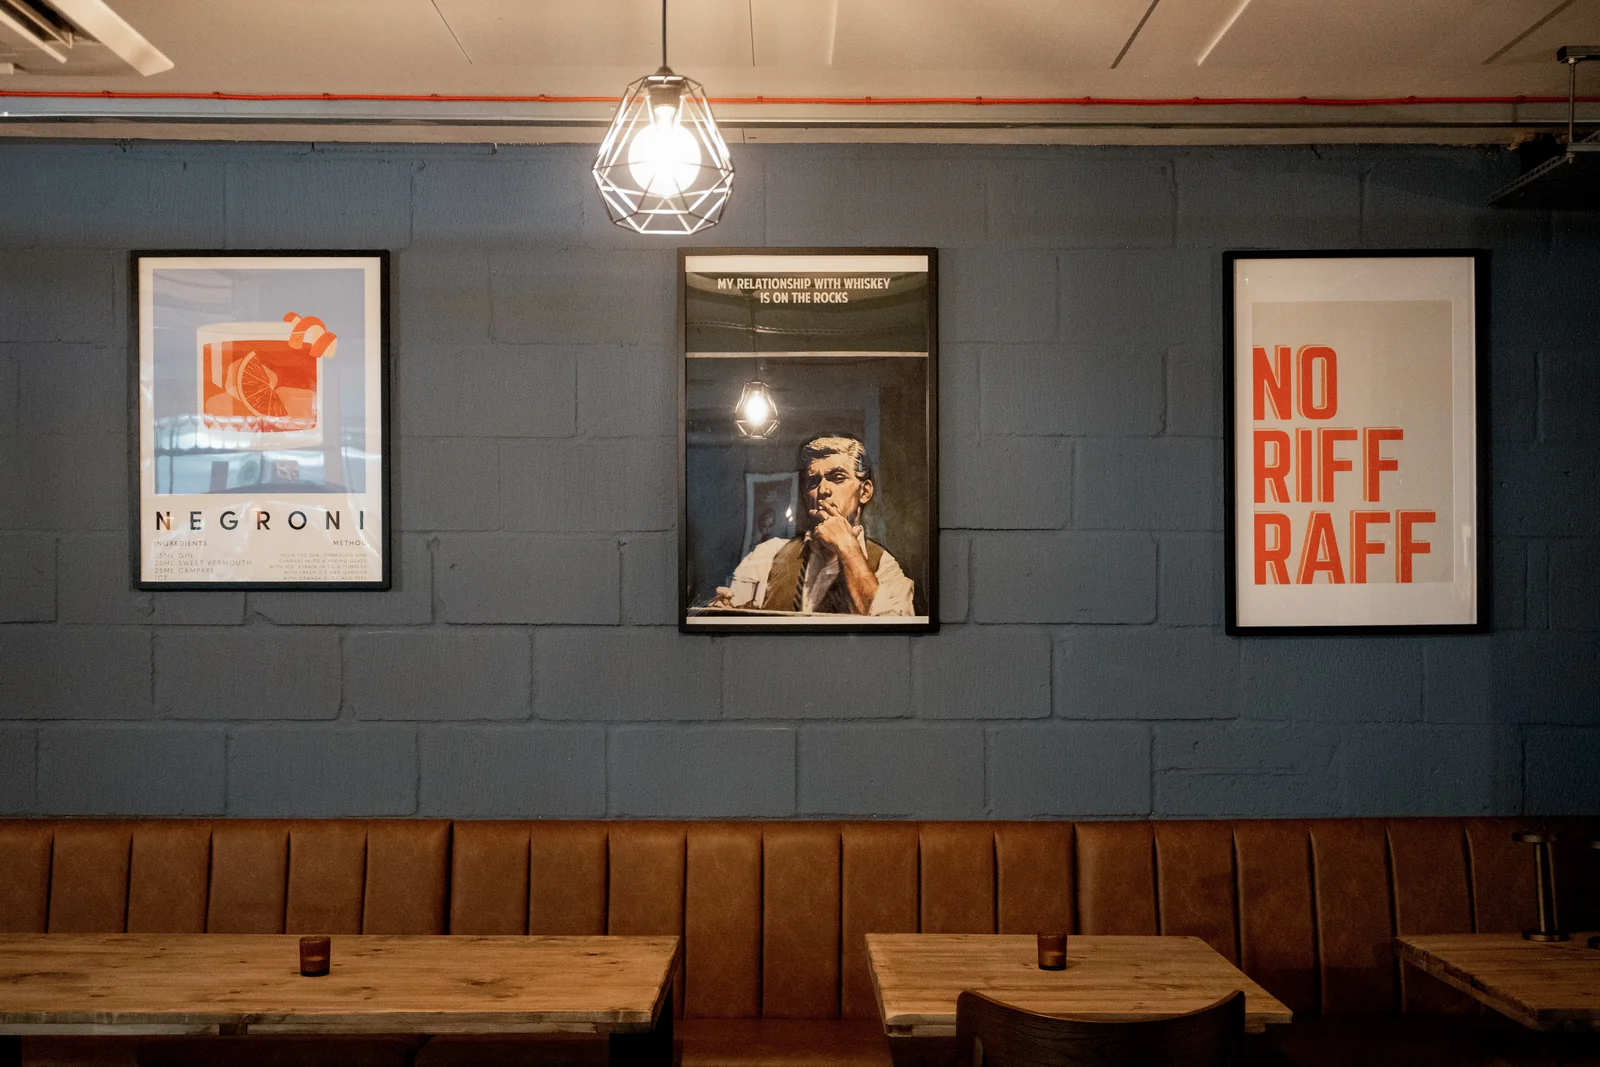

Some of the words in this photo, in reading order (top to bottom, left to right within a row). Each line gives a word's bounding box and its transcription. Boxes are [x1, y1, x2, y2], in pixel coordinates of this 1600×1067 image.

[717, 278, 734, 290] MY
[737, 278, 811, 290] RELATIONSHIP
[813, 278, 841, 290] WITH
[843, 278, 891, 290] WHISKEY
[760, 292, 770, 304] IS
[773, 292, 789, 304] ON
[791, 292, 811, 304] THE
[813, 292, 849, 304] ROCKS
[1252, 344, 1338, 420] NO
[1253, 426, 1404, 503] RIFF
[156, 511, 364, 530] NEGRONI
[1254, 509, 1437, 585] RAFF
